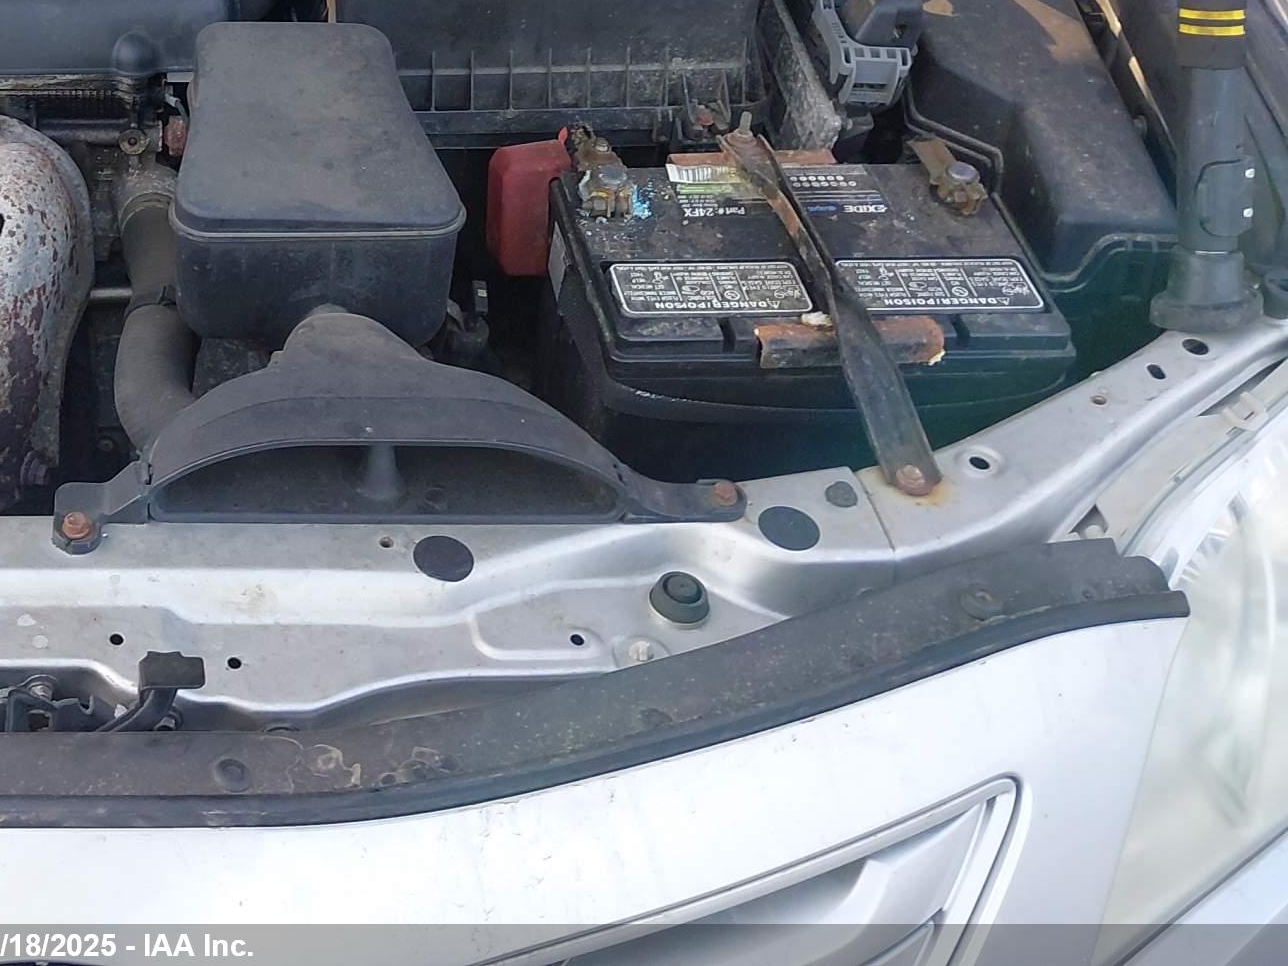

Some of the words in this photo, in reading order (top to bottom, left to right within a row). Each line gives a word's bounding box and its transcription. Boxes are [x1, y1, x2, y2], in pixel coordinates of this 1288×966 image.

[683, 207, 714, 217] 24FX
[726, 207, 745, 215] Part
[842, 204, 888, 213] EXIDE
